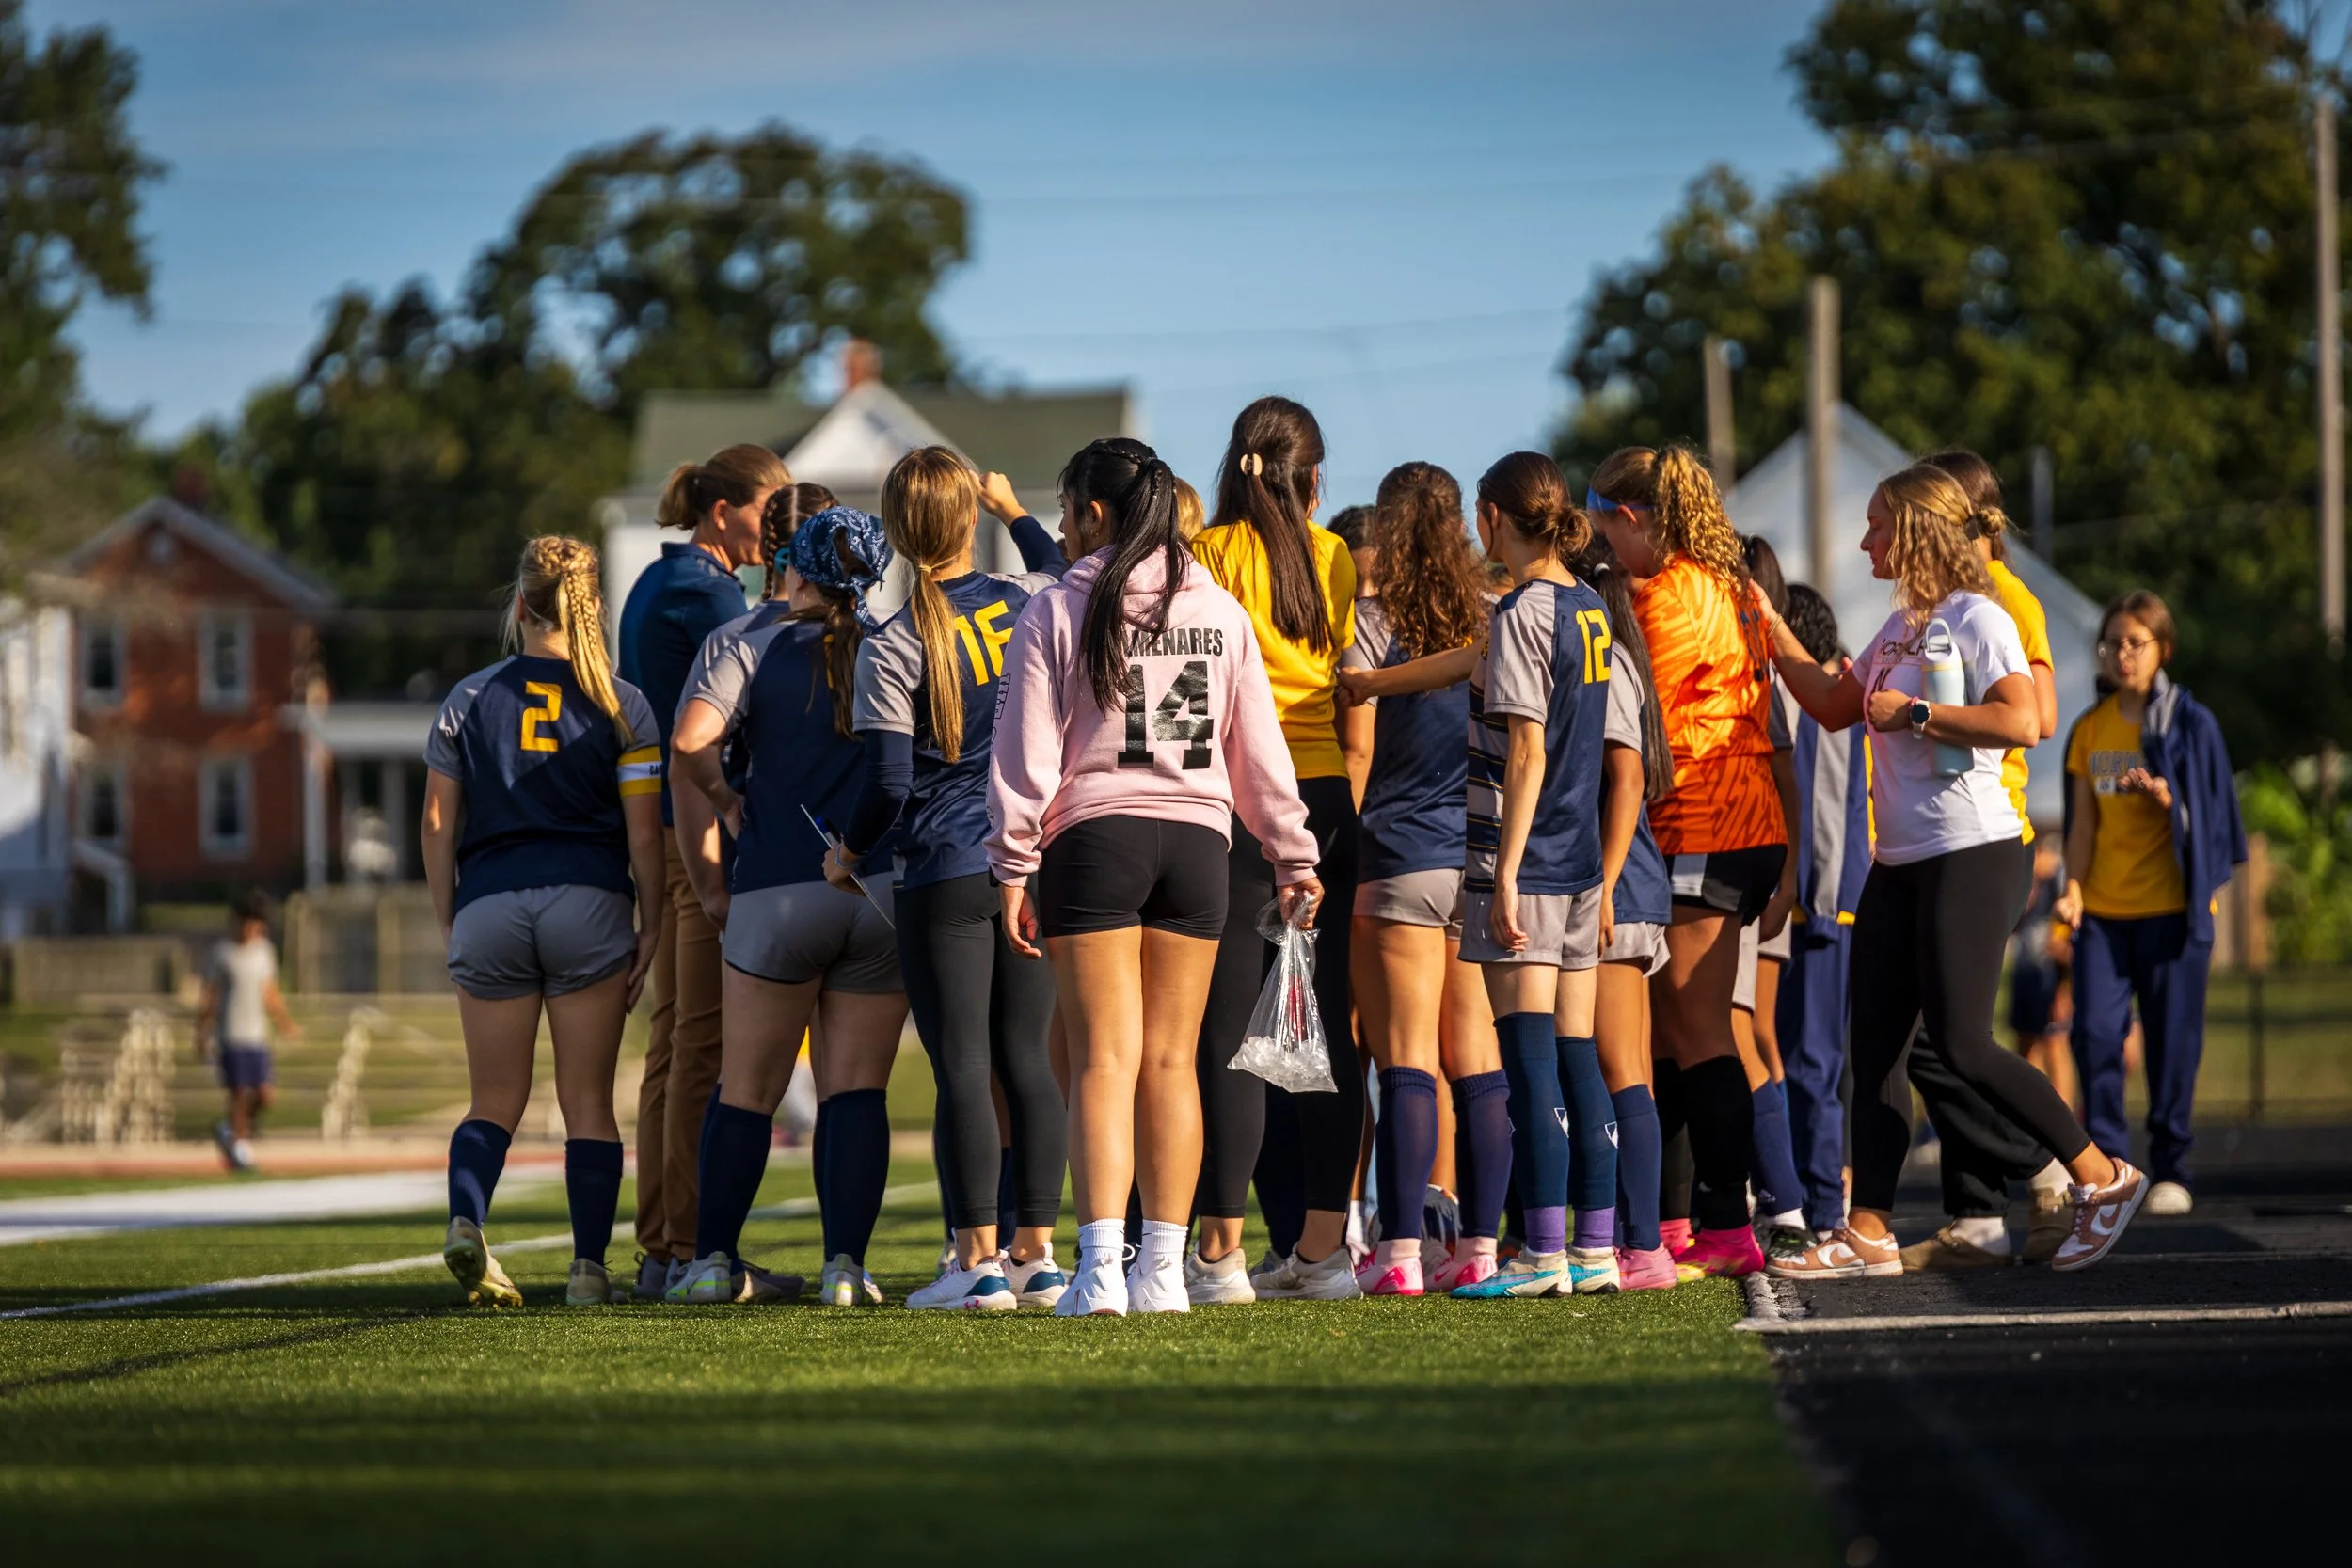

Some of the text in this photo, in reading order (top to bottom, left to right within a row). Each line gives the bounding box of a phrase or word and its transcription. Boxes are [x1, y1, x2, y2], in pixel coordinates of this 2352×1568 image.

[1575, 609, 1612, 684] 12
[520, 680, 563, 752] 2
[1117, 660, 1215, 769] 14
